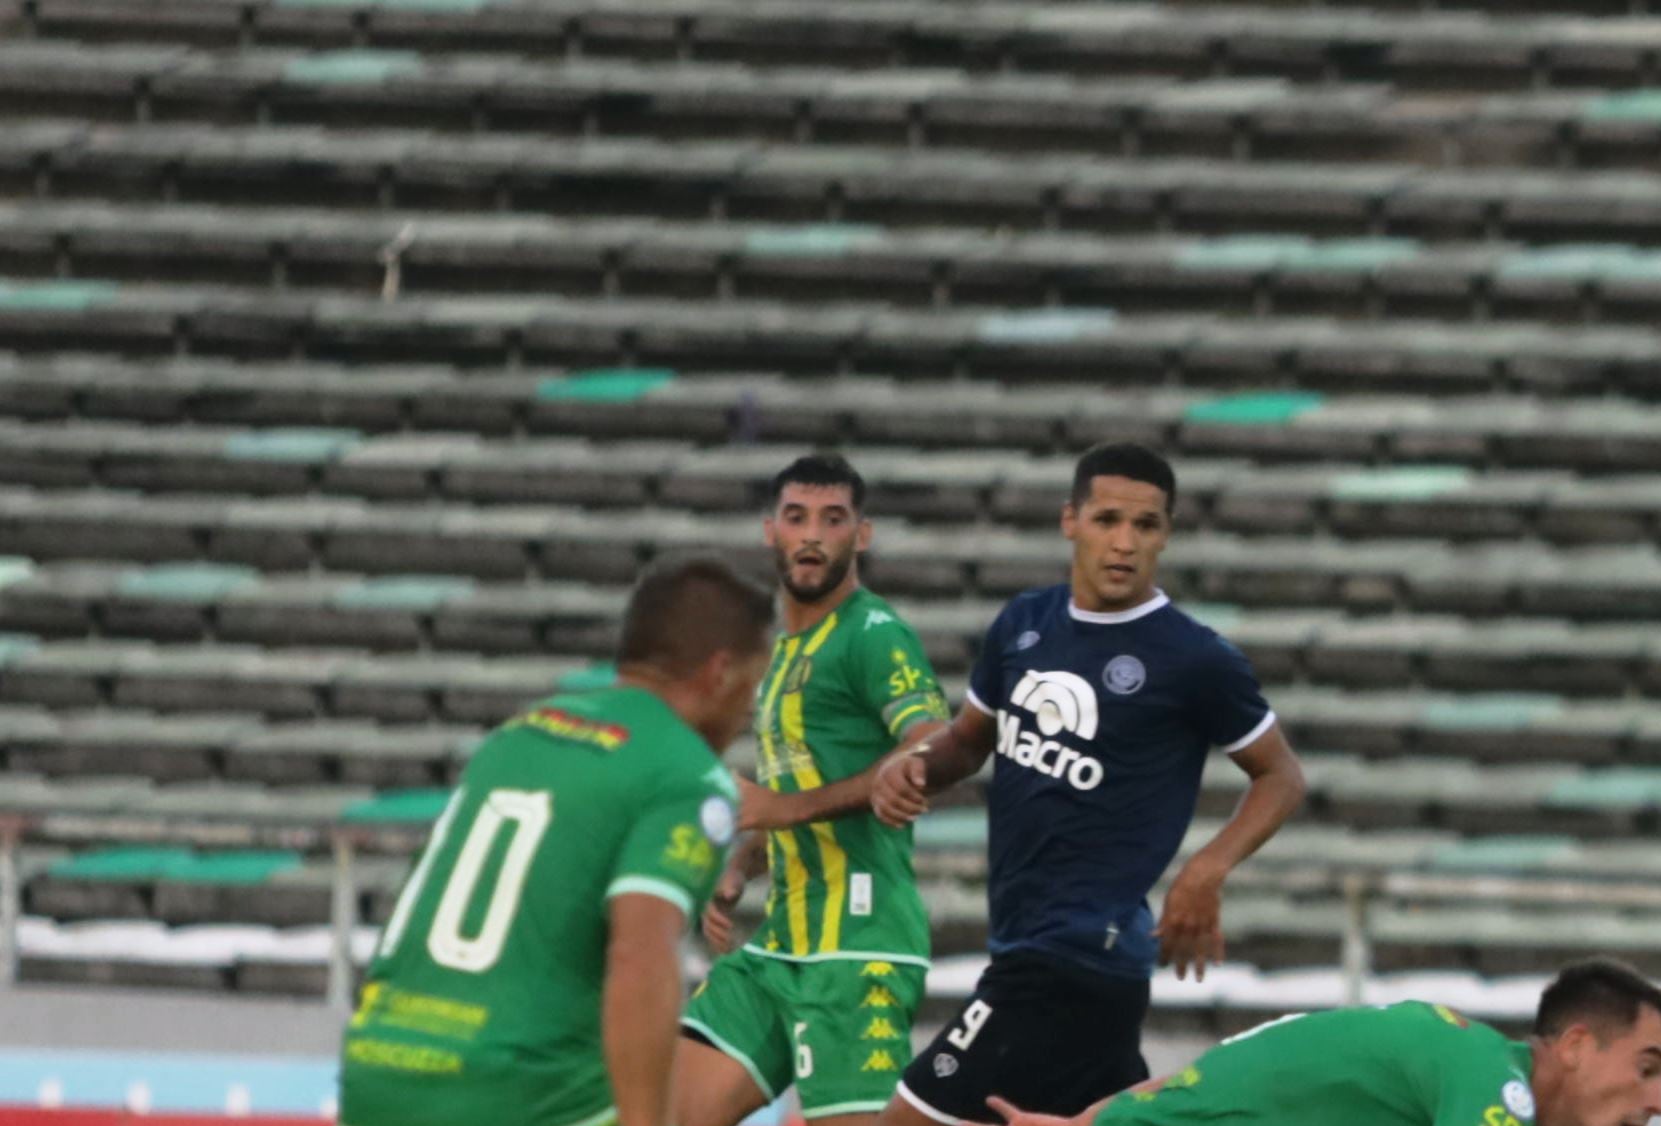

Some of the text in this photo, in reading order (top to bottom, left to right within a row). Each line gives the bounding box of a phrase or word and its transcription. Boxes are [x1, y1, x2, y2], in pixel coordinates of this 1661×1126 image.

[996, 708, 1105, 792] Macro
[379, 784, 553, 973] 10
[947, 998, 993, 1051] 9
